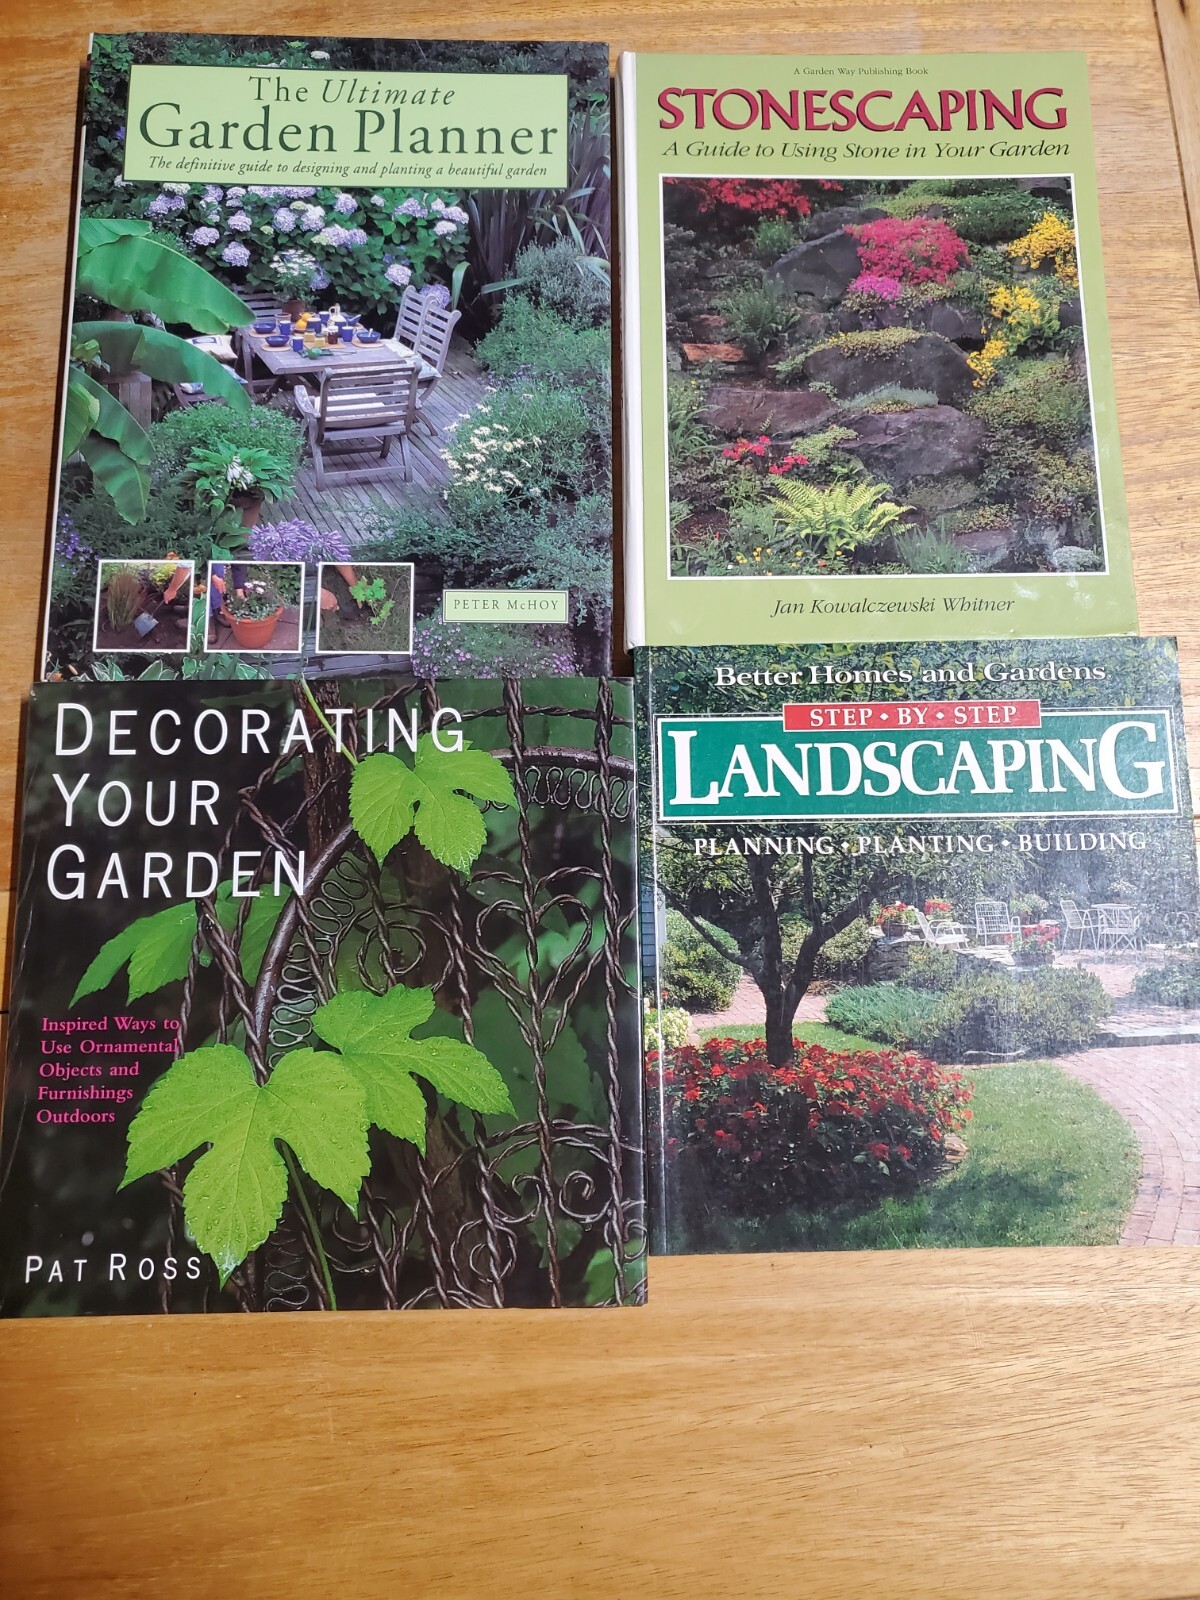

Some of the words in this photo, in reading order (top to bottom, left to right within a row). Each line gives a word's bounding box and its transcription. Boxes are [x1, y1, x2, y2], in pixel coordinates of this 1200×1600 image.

[794, 68, 800, 76] A
[802, 67, 835, 75] Garden
[838, 67, 855, 77] Way
[858, 67, 903, 76] Publishing
[906, 67, 929, 75] Book
[249, 75, 309, 103] The
[321, 79, 456, 106] Ultimate
[658, 87, 1067, 132] STONESCAPING
[139, 102, 336, 152] Garden
[353, 107, 558, 155] Planner
[662, 142, 679, 156] A
[686, 141, 750, 157] Guide
[756, 143, 775, 157] to
[782, 142, 838, 162] Using
[843, 144, 902, 159] Stone
[905, 143, 927, 157] in
[935, 142, 984, 158] Your
[989, 141, 1070, 157] Garden
[148, 156, 172, 170] The
[175, 157, 236, 173] definitive
[240, 161, 273, 174] guide
[277, 162, 288, 173] to
[292, 161, 350, 177] designing
[353, 162, 377, 174] and
[381, 163, 432, 178] planting
[436, 167, 444, 175] a
[448, 162, 503, 178] beautiful
[506, 163, 548, 178] garden
[454, 599, 500, 610] PETER
[507, 600, 559, 610] McHOY
[770, 600, 805, 618] Jan
[810, 598, 935, 614] Kowalczewski
[942, 597, 1015, 612] Whitner
[715, 666, 801, 687] Better
[809, 665, 912, 685] Homes
[922, 664, 974, 682] and
[810, 709, 873, 727] STEP
[897, 708, 928, 725] BY
[954, 706, 1017, 725] STEP
[55, 702, 465, 756] DECORATING
[667, 721, 1165, 805] LANDSCAPING
[52, 773, 220, 827] YOUR
[694, 836, 833, 856] PLANNING
[858, 835, 994, 854] PLANTING
[1019, 832, 1147, 851] BUILDING
[47, 844, 305, 899] GARDEN
[42, 1017, 108, 1035] Inspired
[113, 1016, 156, 1033] Ways
[163, 1017, 180, 1030] to
[41, 1040, 72, 1054] Use
[80, 1038, 179, 1053] Ornamental
[39, 1062, 102, 1080] Objects
[109, 1062, 140, 1076] and
[38, 1085, 133, 1103] Furnishings
[36, 1108, 115, 1124] Outdoors
[25, 1255, 87, 1283] PAT
[109, 1253, 201, 1281] ROSS
